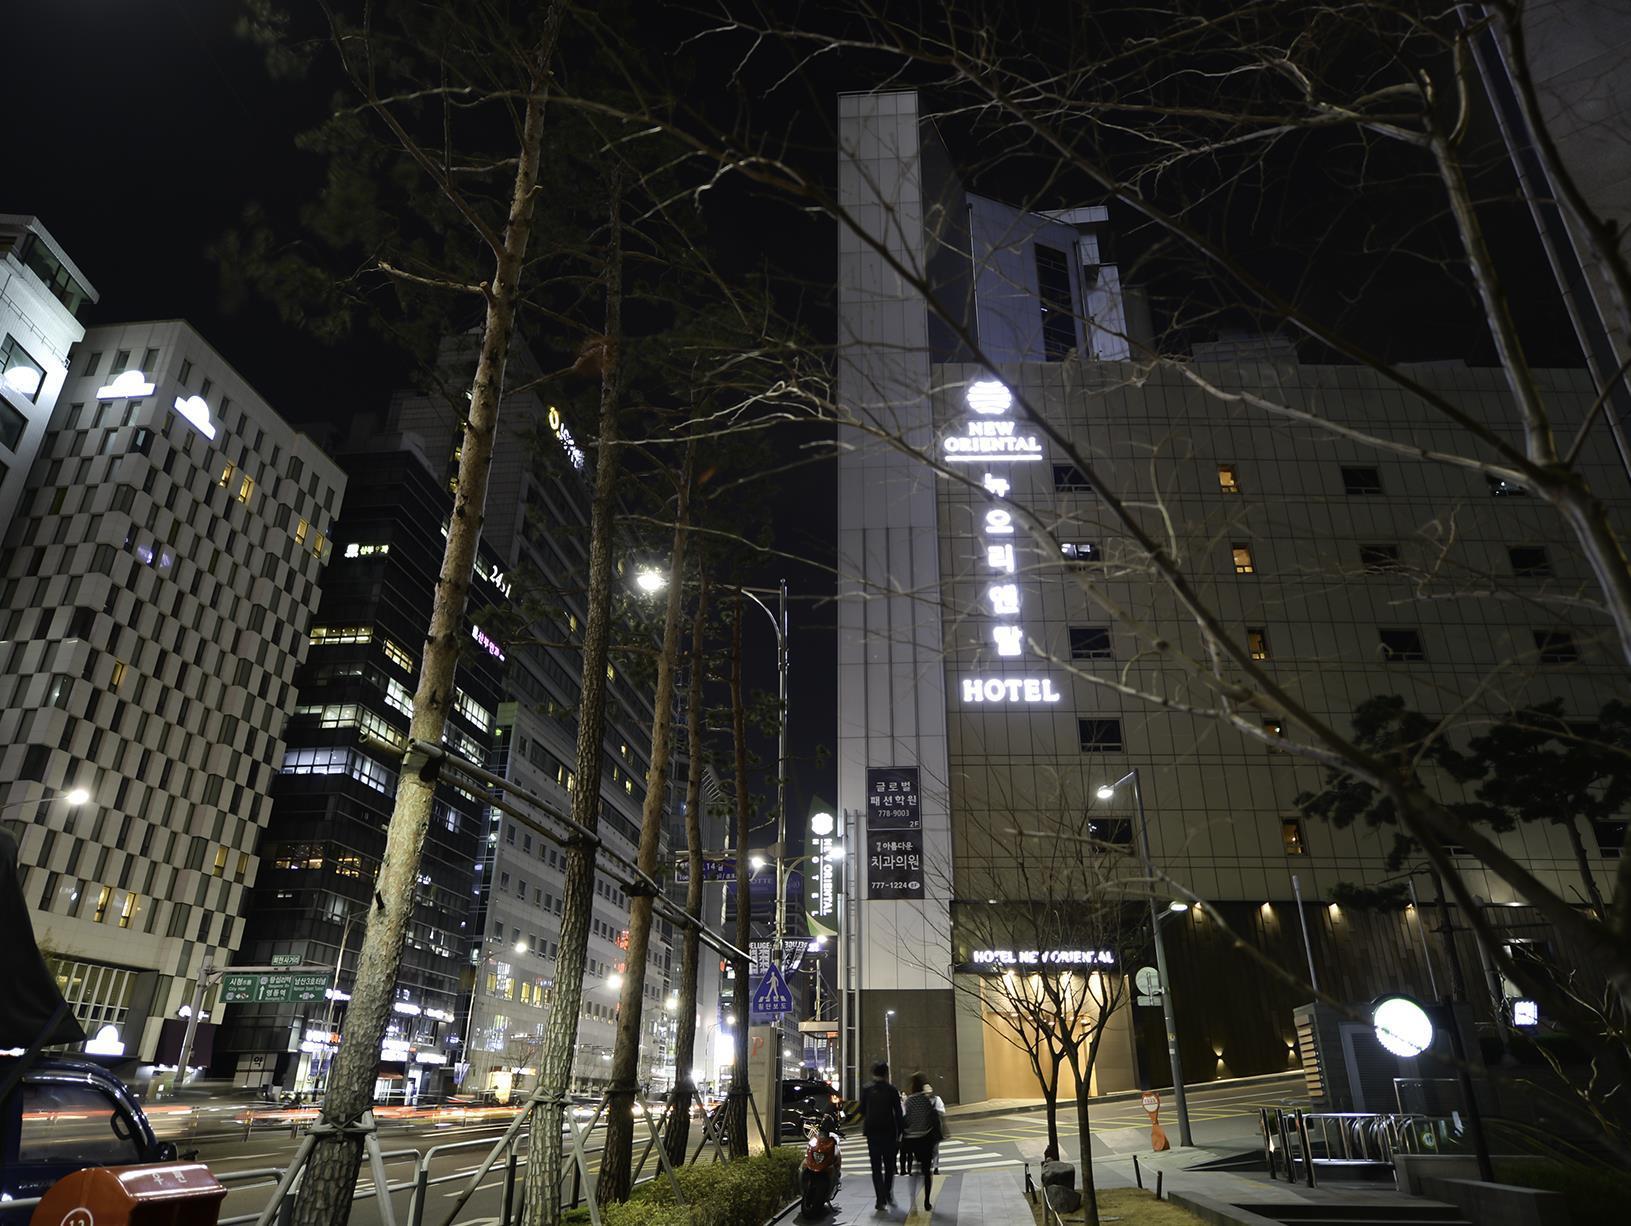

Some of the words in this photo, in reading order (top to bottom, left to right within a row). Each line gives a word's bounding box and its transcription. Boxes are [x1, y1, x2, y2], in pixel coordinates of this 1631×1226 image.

[968, 421, 1015, 436] NEW
[944, 437, 1041, 452] ORIENTAL
[963, 679, 1060, 702] HOTEL
[875, 782, 911, 792] 글로벌
[870, 795, 917, 806] 패션학원
[882, 841, 913, 851] 아름다운
[871, 854, 919, 870] 치과의원
[811, 838, 820, 917] HOTEL
[871, 881, 907, 889] 777-1224
[823, 864, 833, 916] ORIENTAL
[253, 1056, 264, 1068] 약
